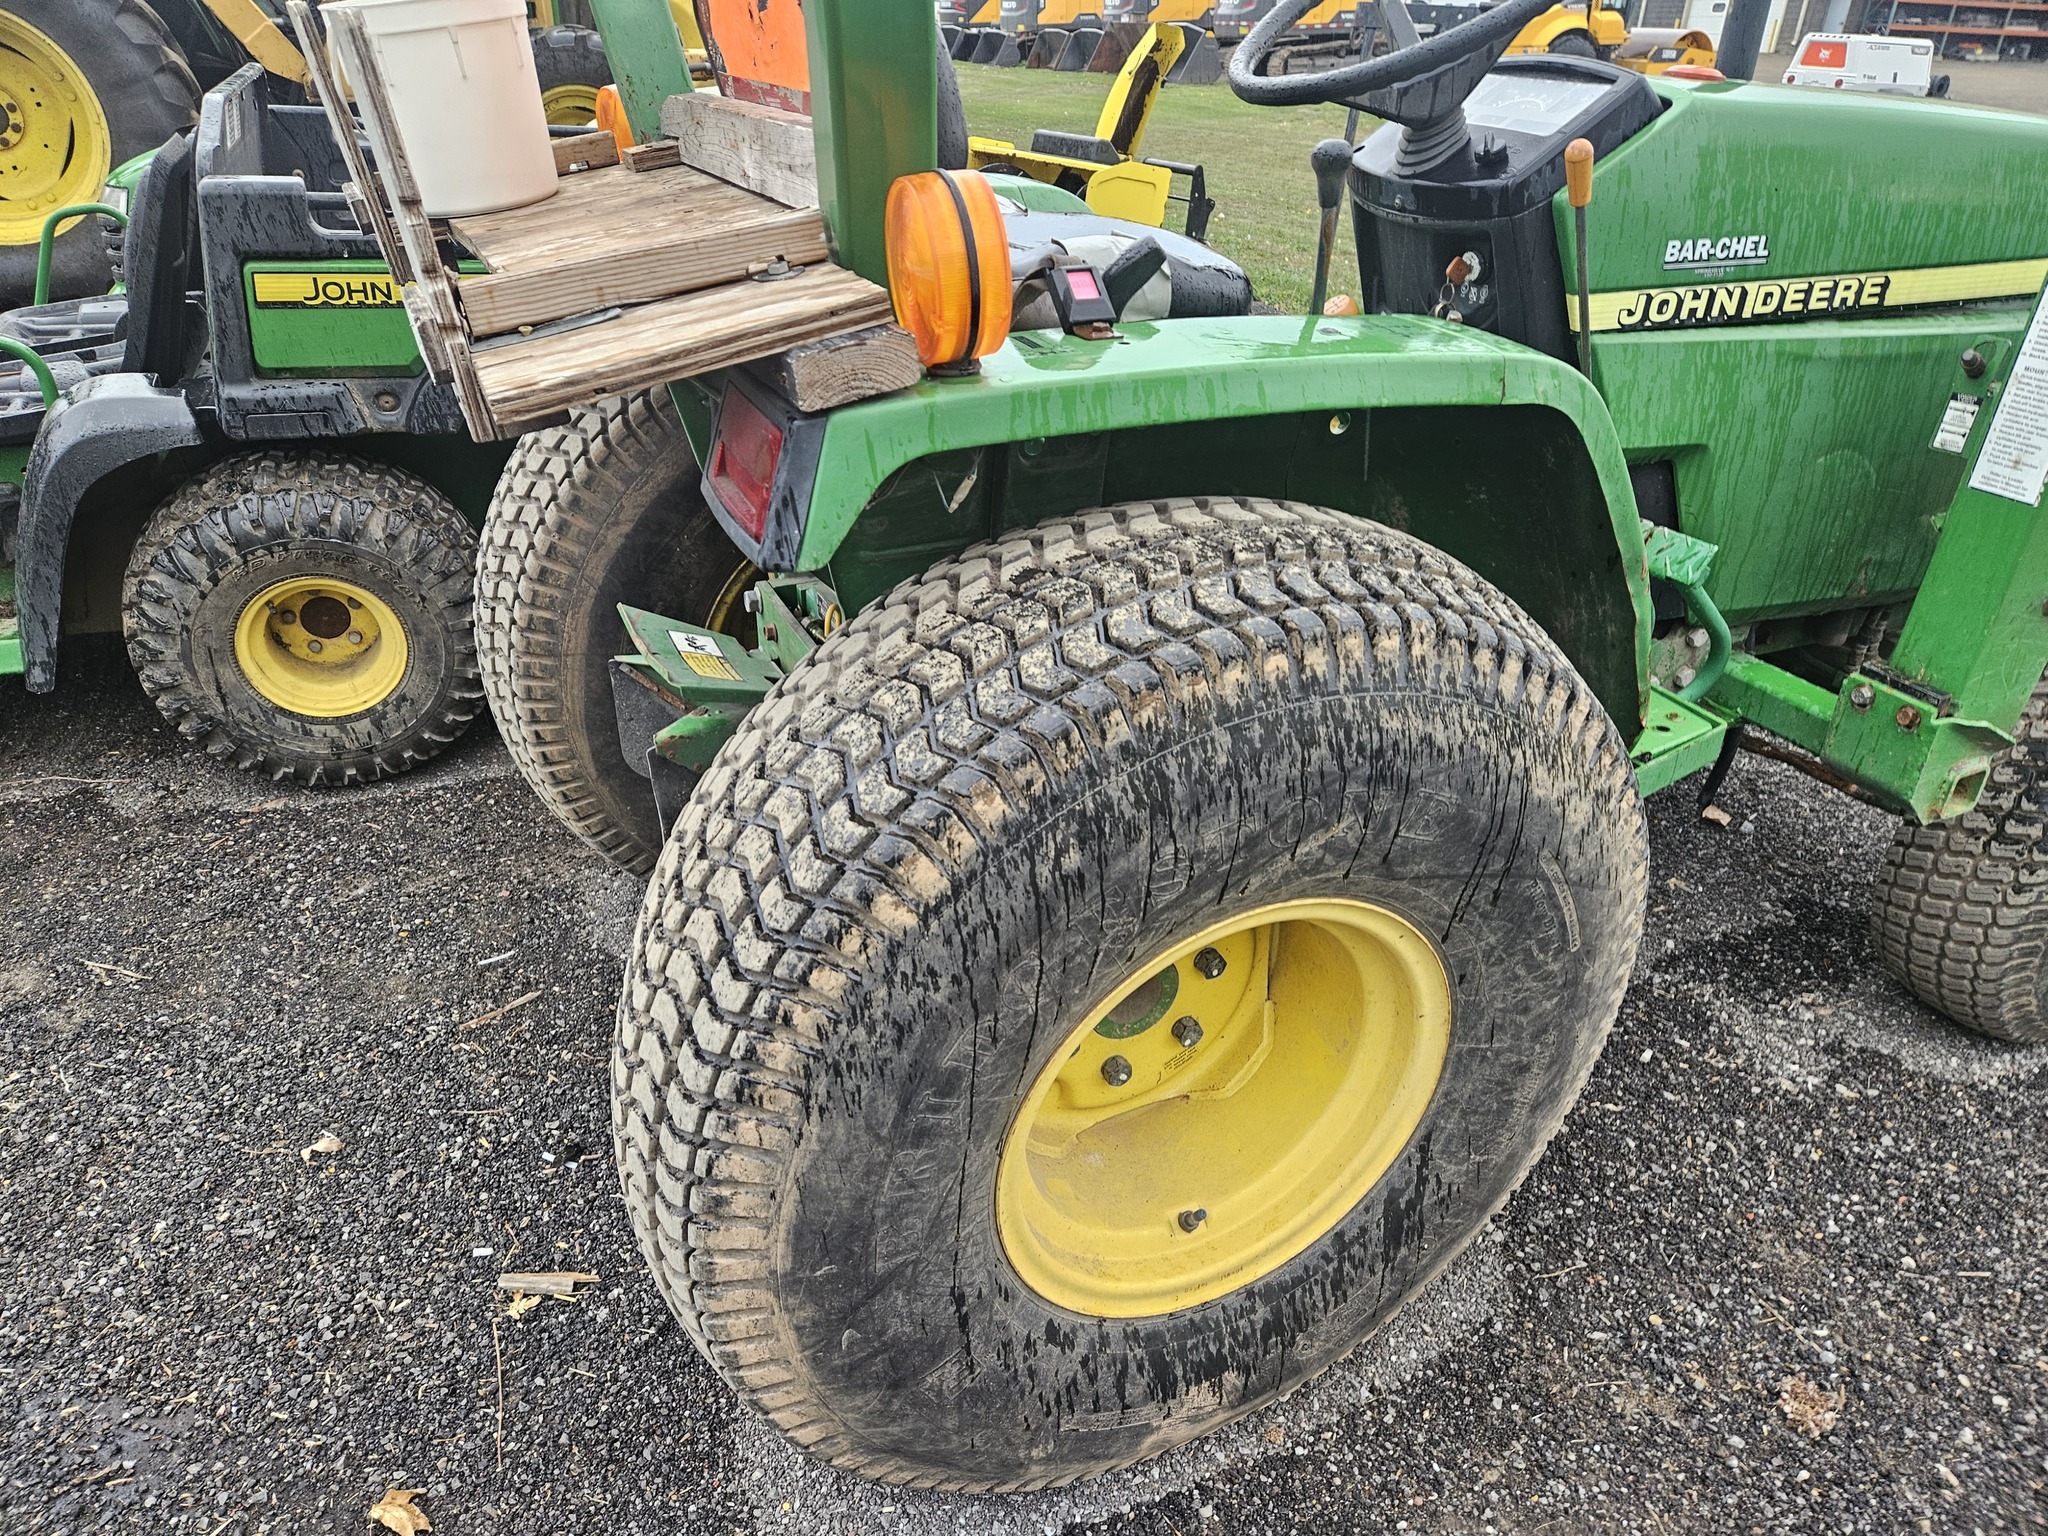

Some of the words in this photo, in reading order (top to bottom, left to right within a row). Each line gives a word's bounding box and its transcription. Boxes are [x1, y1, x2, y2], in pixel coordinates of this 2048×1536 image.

[1664, 234, 1770, 263] BAR-CHEL
[303, 276, 394, 303] JOHN
[1618, 285, 1744, 327] JOHN
[1753, 275, 1889, 316] DEERE
